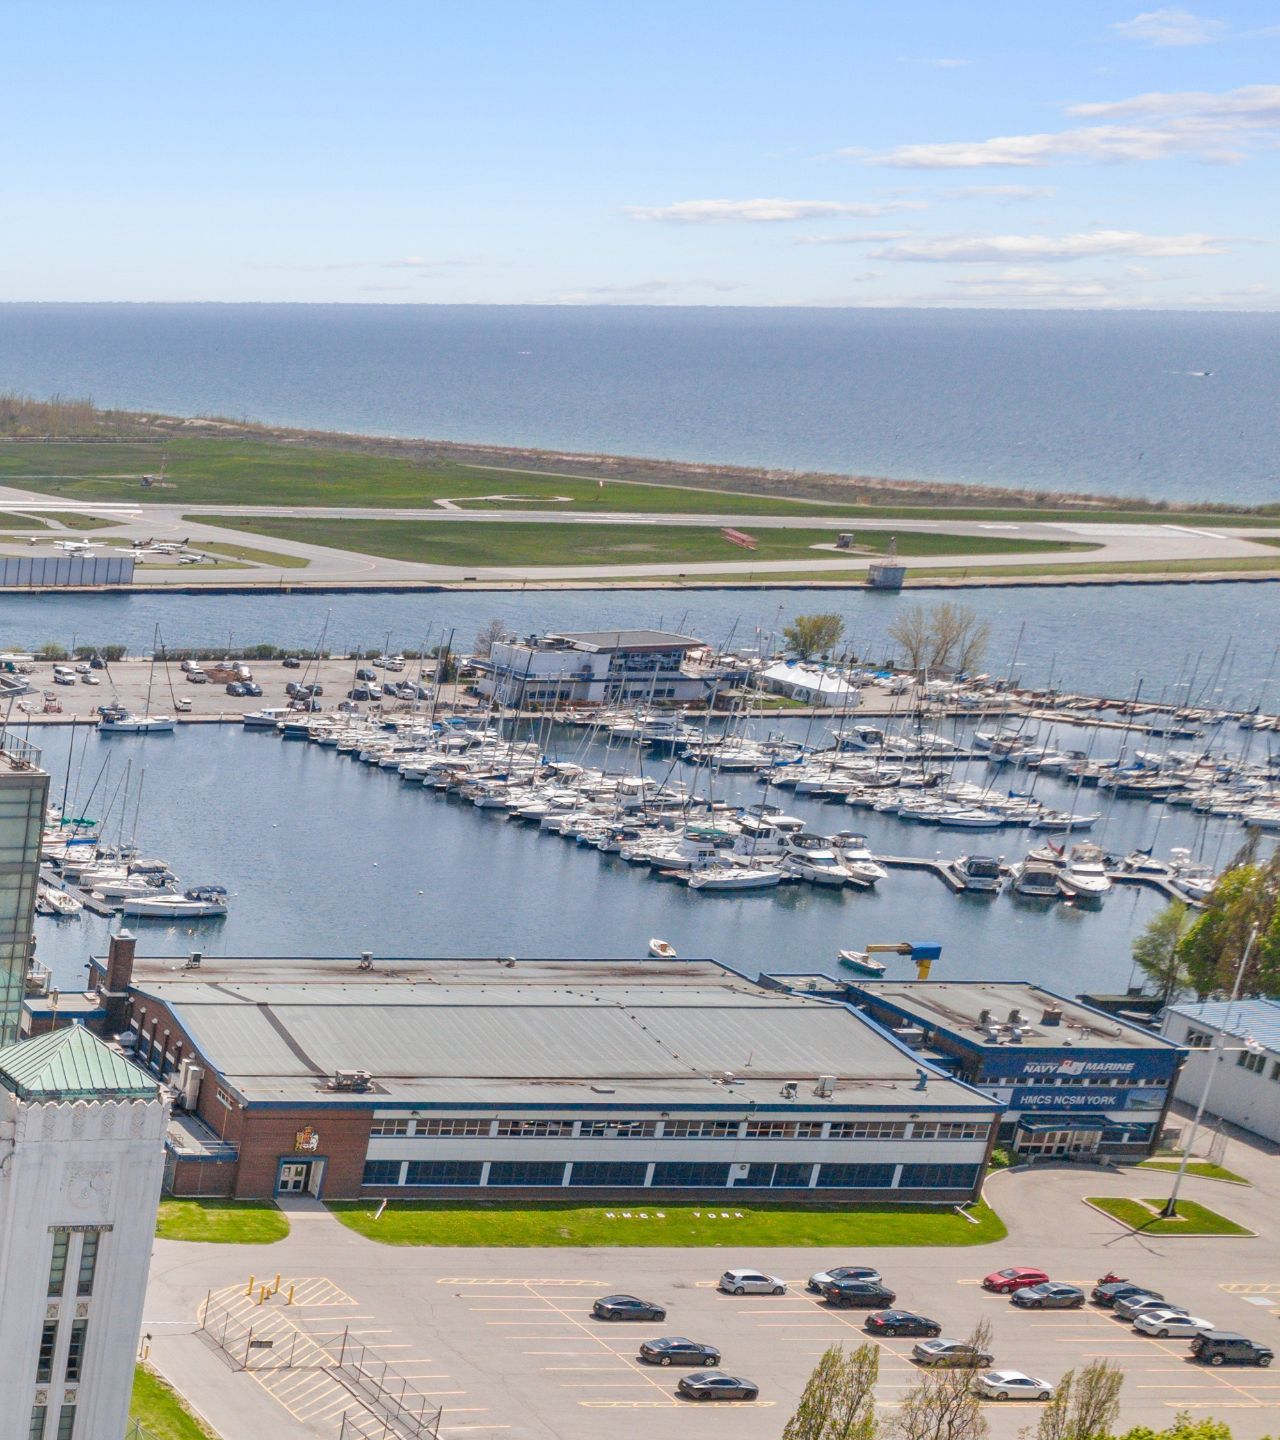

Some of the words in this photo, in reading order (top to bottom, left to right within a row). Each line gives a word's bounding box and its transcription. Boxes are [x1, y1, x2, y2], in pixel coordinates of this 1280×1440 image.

[1023, 1065, 1058, 1073] NAVY
[1085, 1062, 1136, 1071] MARINE
[1020, 1095, 1052, 1104] HMCS
[1053, 1095, 1085, 1104] NCSM
[1087, 1095, 1117, 1105] YORK
[693, 1211, 744, 1219] YORK
